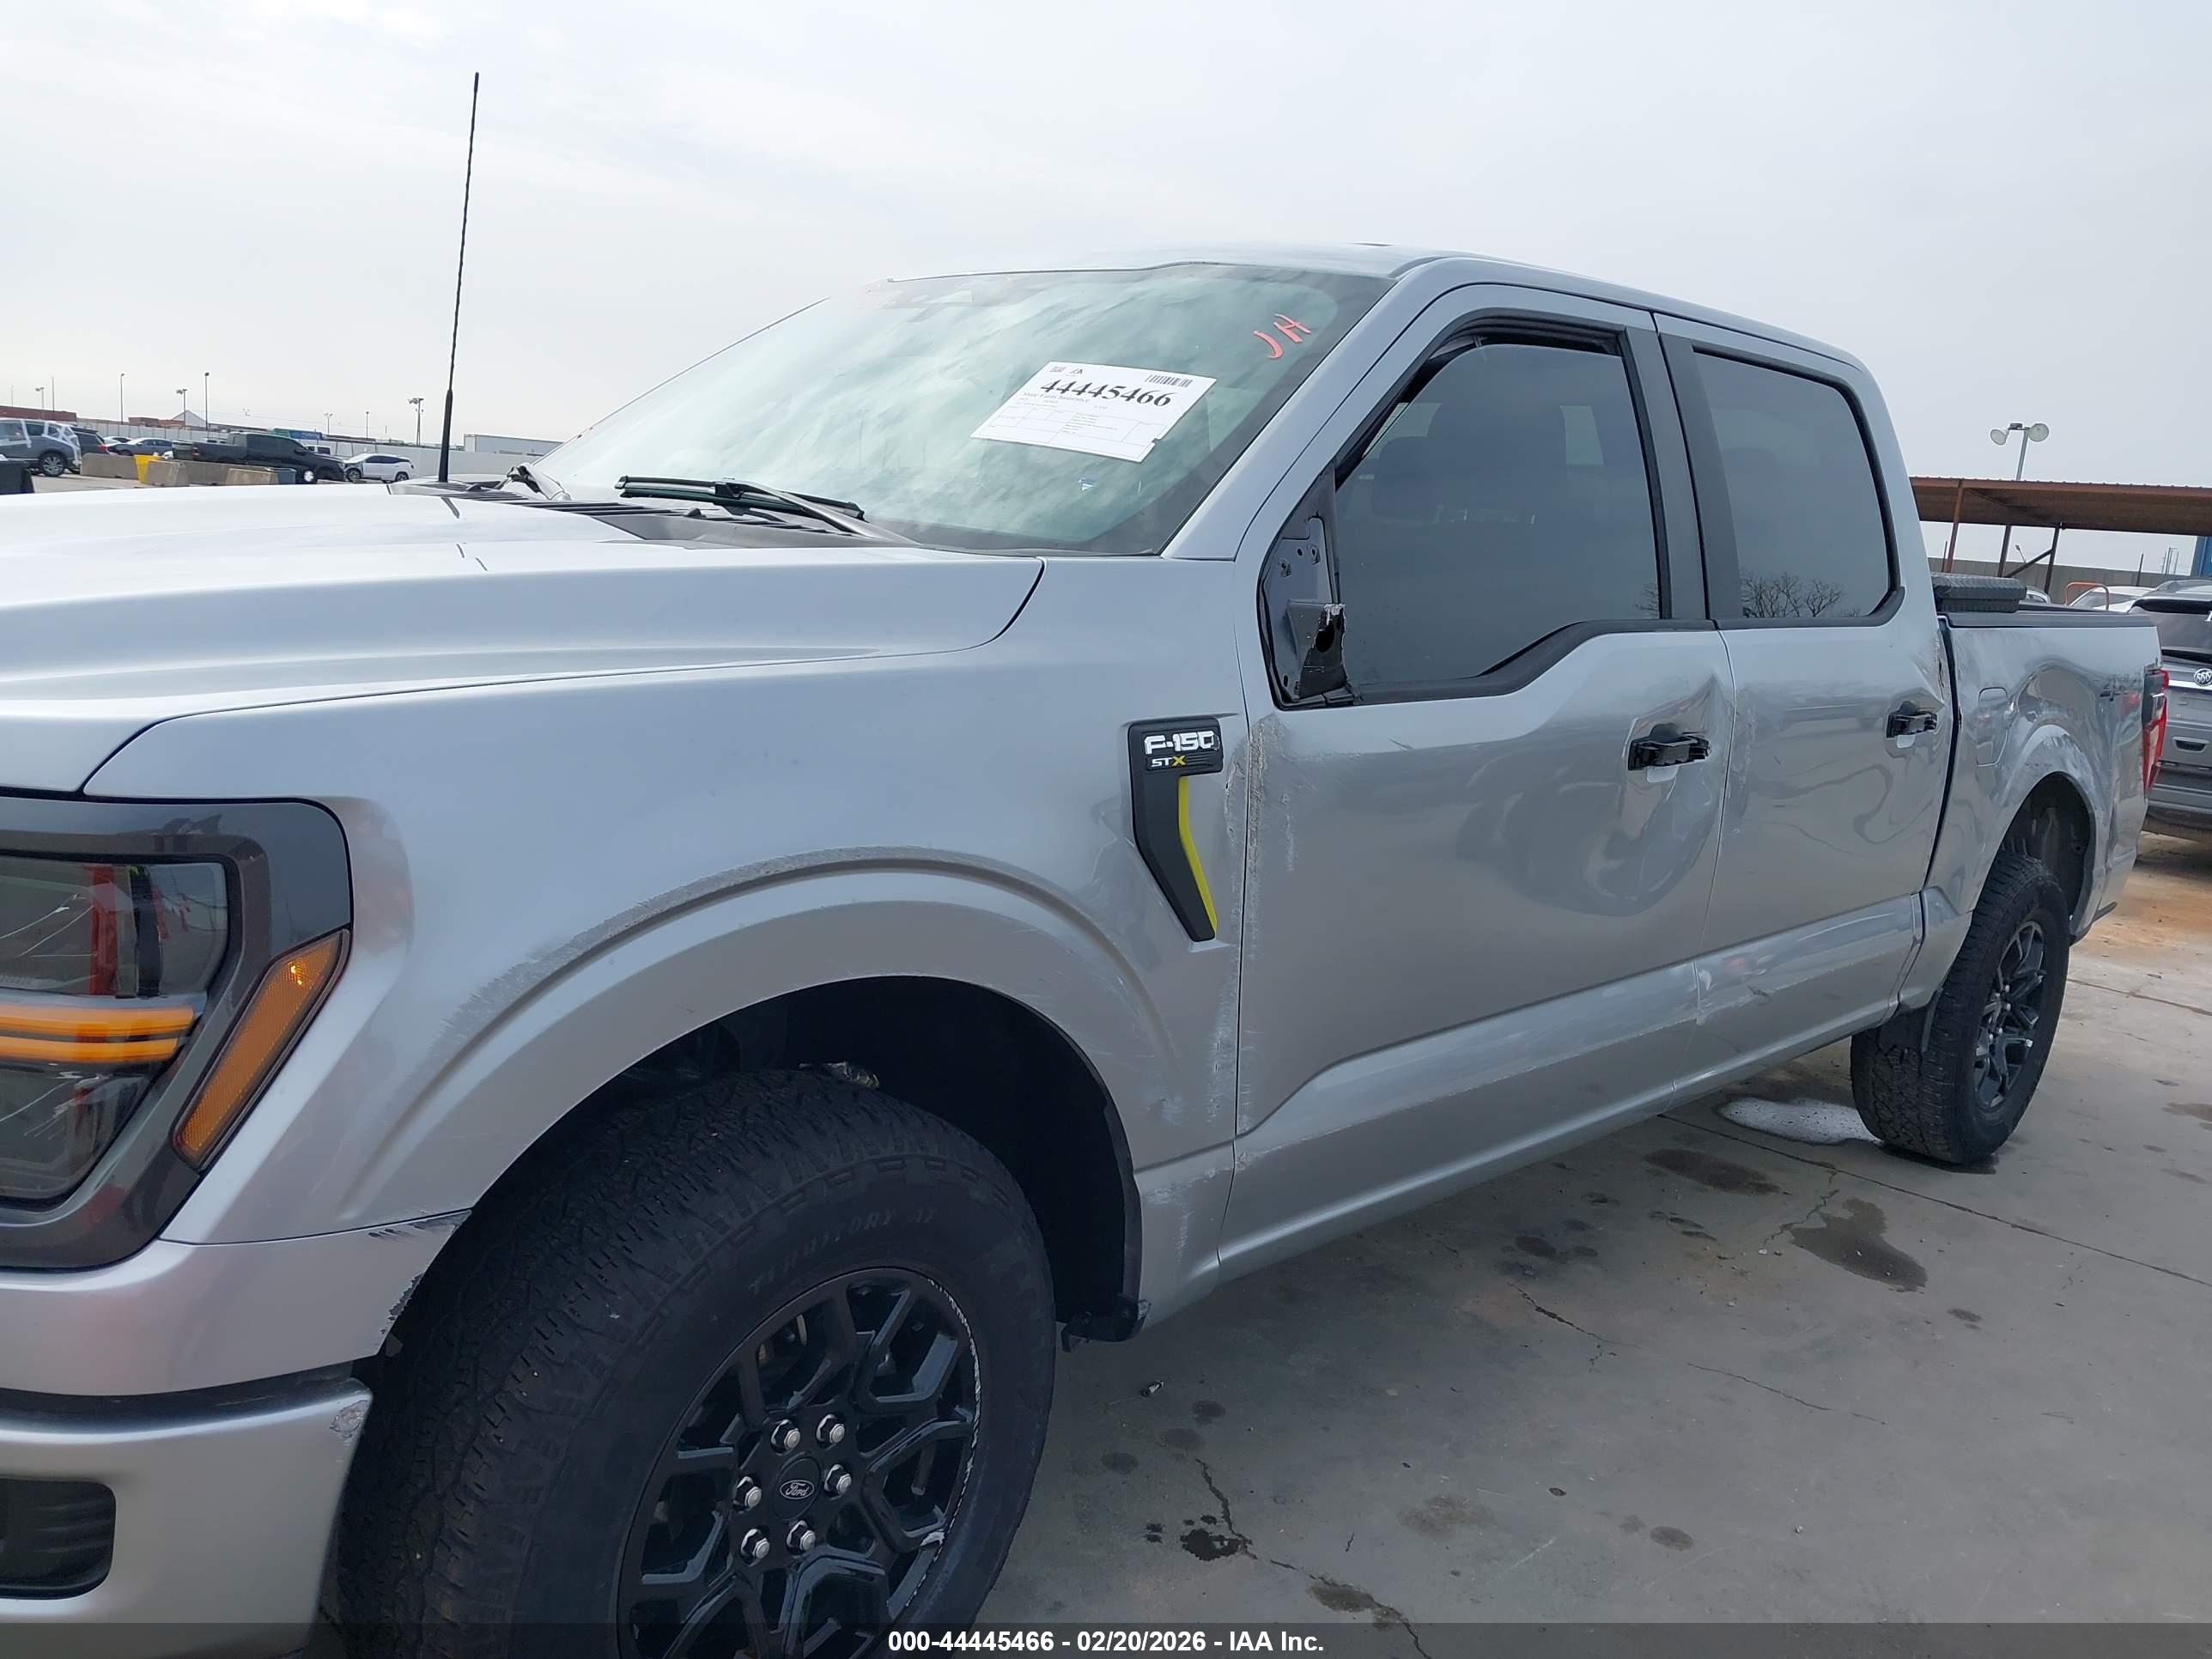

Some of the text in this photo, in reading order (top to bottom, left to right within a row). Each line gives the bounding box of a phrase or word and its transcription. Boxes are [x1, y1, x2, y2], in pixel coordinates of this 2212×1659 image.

[1040, 380, 1177, 406] 44445466
[1144, 730, 1217, 755] F-150
[1152, 756, 1186, 768] STX
[785, 1482, 810, 1496] Ford
